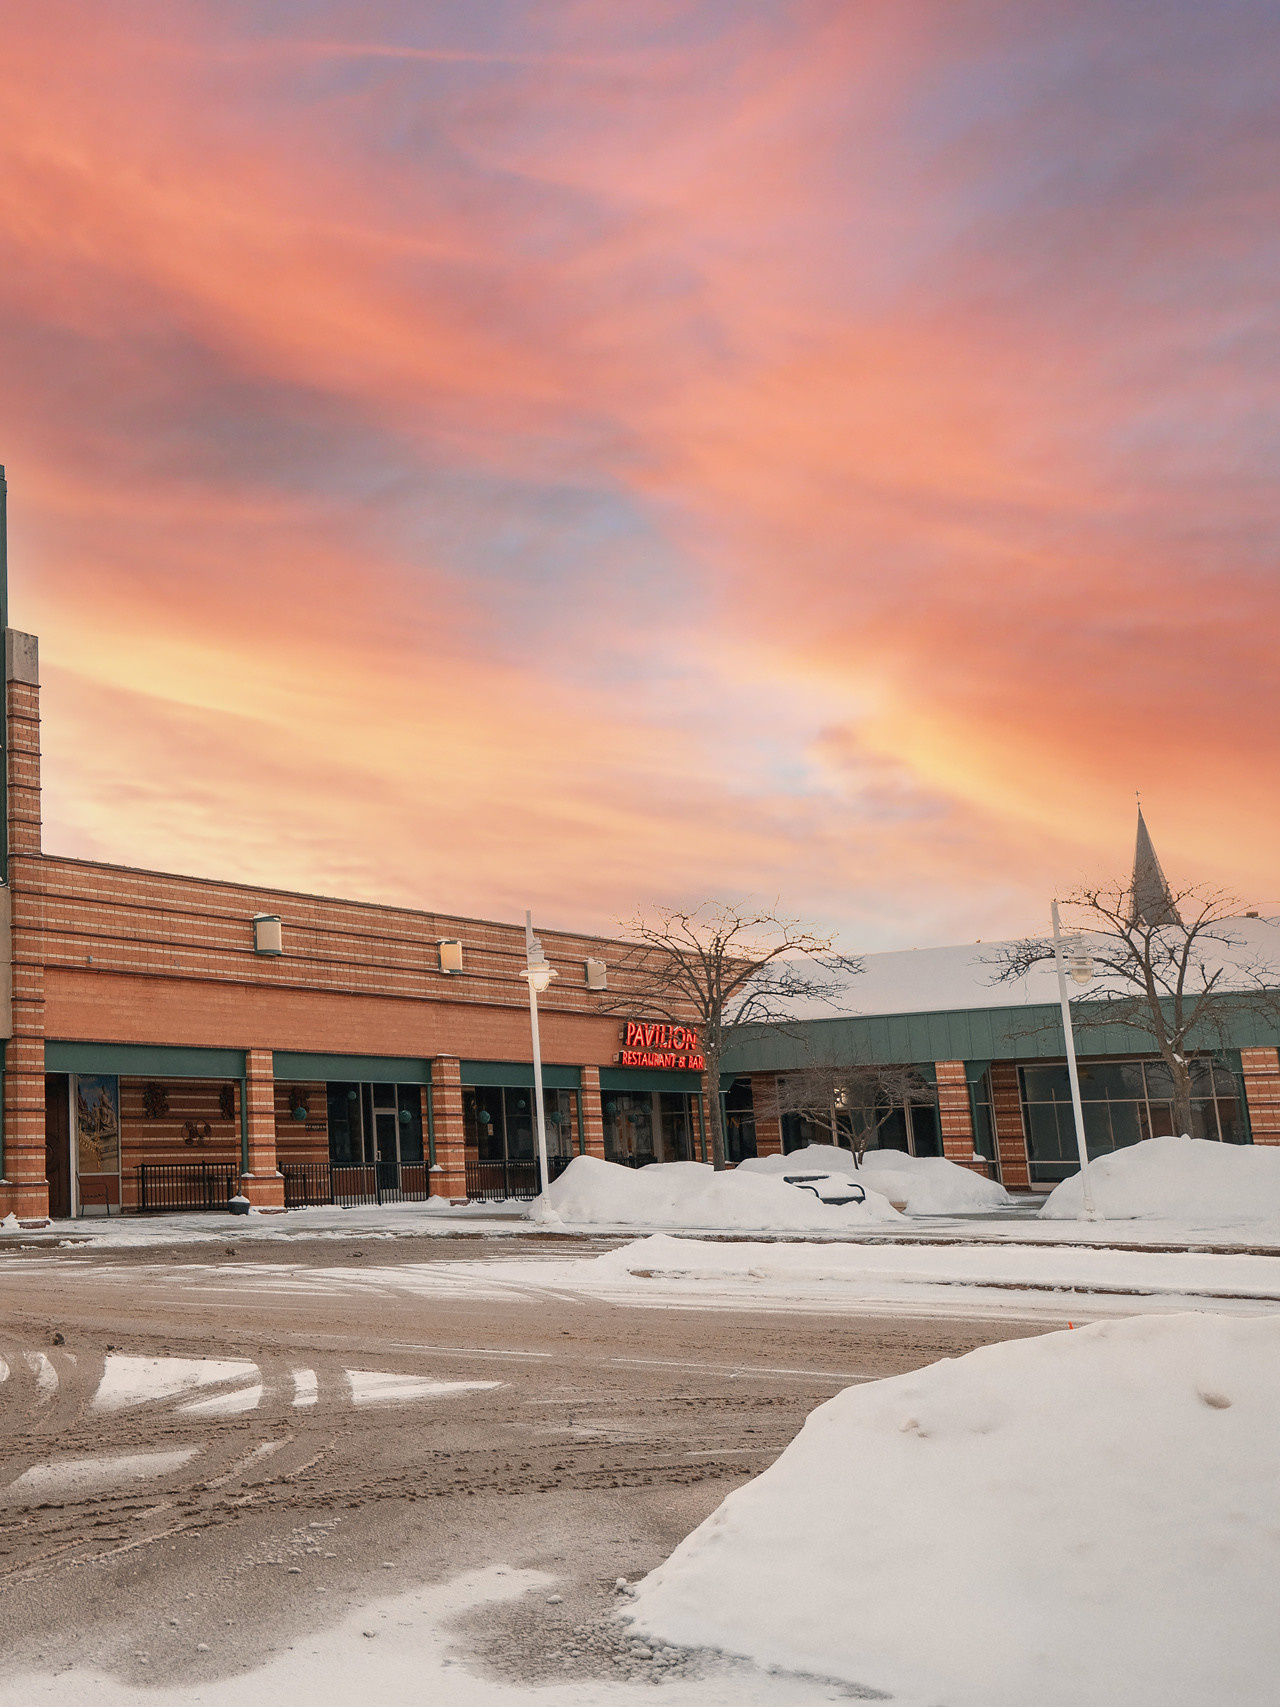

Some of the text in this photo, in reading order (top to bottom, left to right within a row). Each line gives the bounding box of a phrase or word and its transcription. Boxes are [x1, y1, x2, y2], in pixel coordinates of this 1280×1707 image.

[626, 1022, 697, 1050] PAVILION
[622, 1050, 704, 1069] RESTAURANT & BAR
